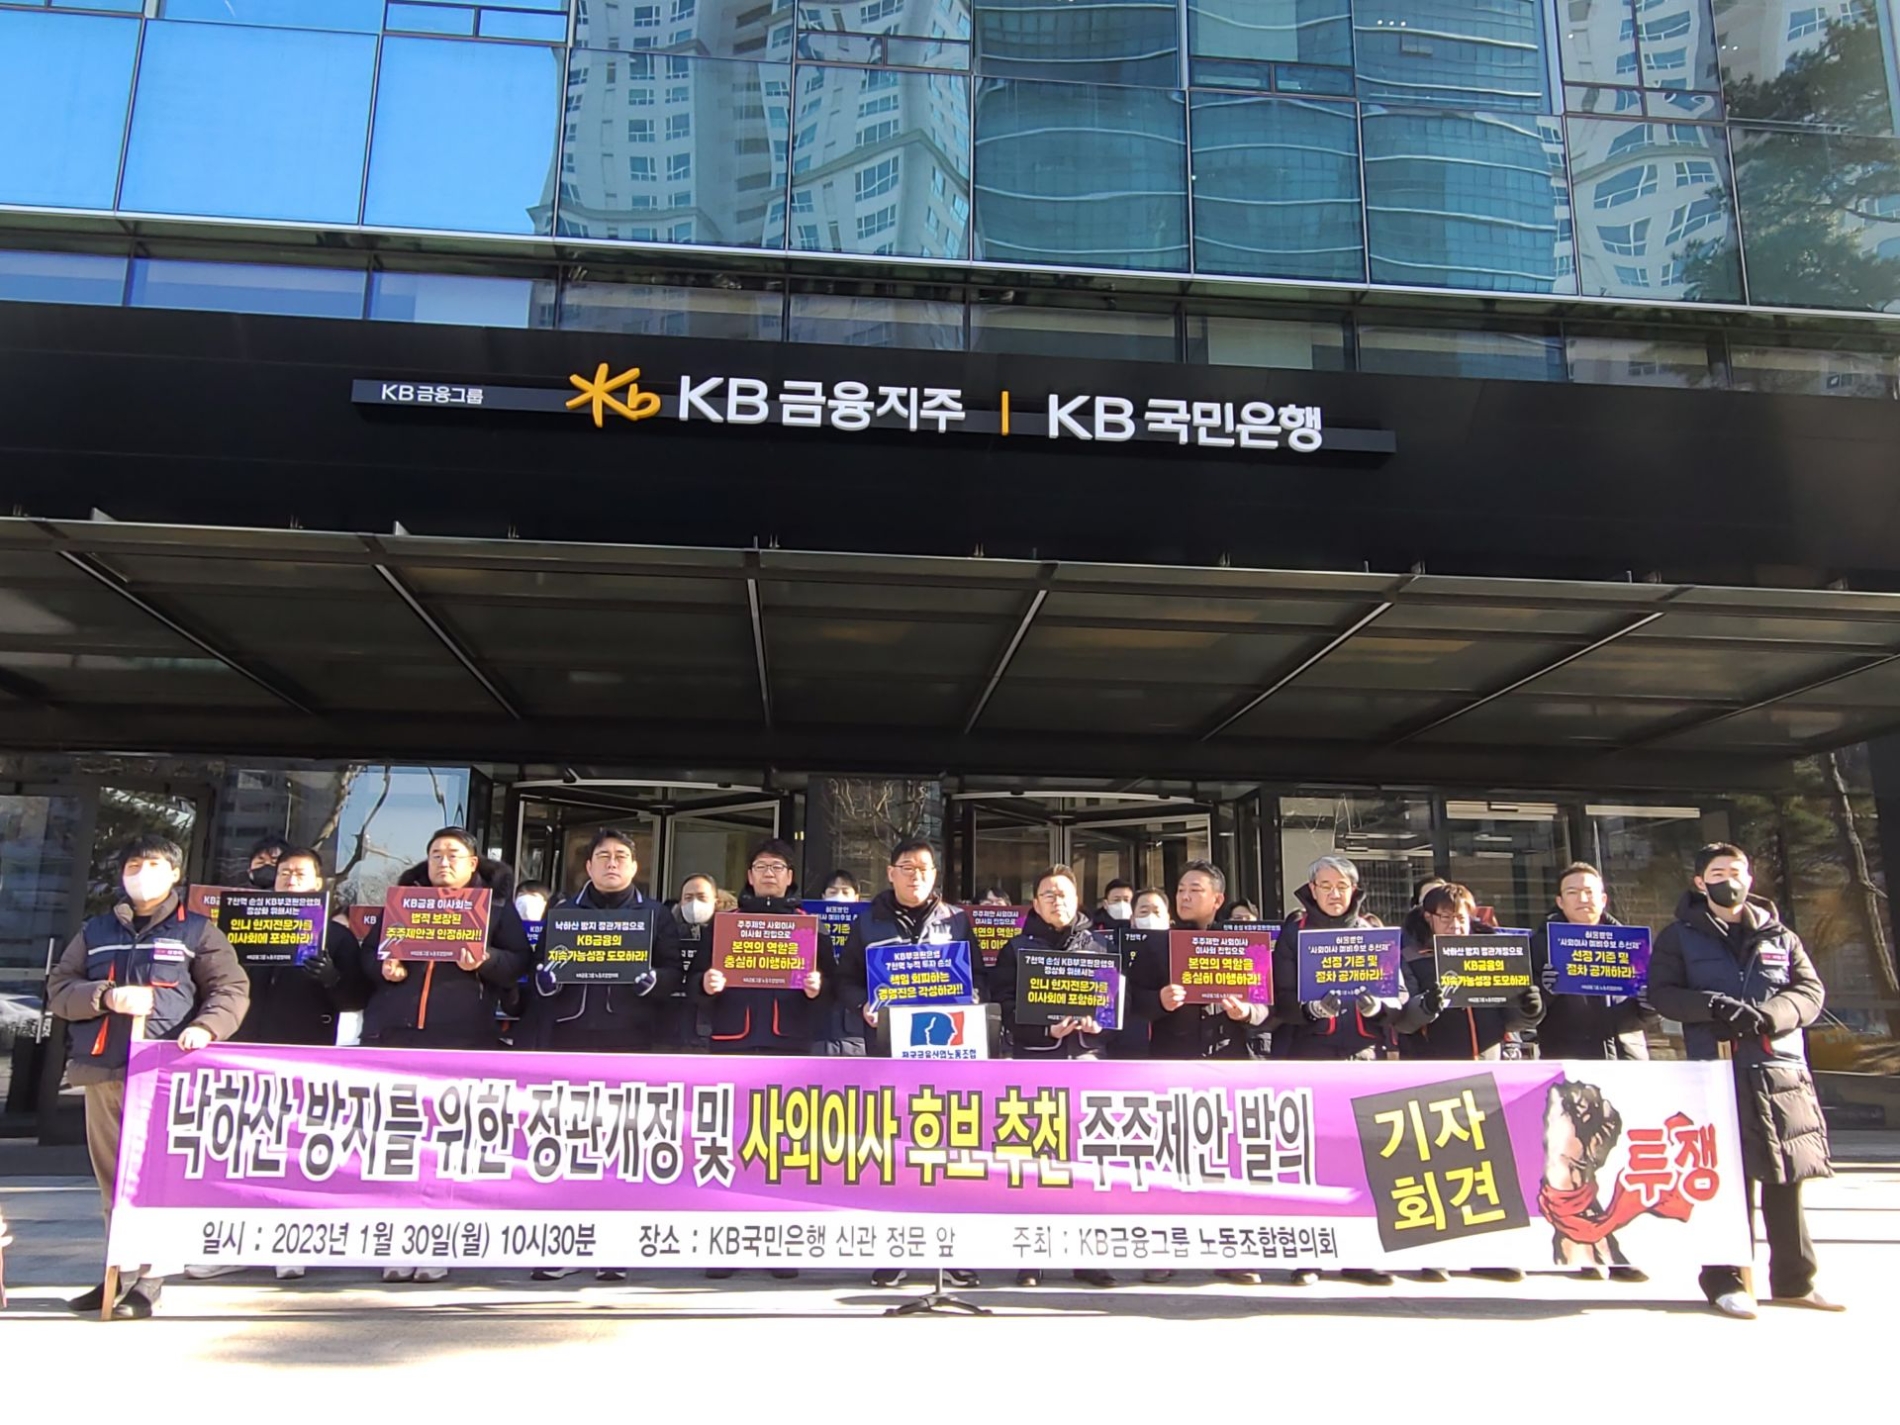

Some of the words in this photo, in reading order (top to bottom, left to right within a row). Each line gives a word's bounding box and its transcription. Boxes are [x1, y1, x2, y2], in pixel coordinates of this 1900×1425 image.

[381, 384, 484, 405] KB금융그룹
[679, 375, 966, 434] KB금융지주
[1048, 394, 1323, 453] KB국민은행
[403, 898, 435, 908] KB금융
[437, 899, 473, 910] 이사회는
[230, 918, 251, 930] 인니
[411, 912, 431, 924] 법적
[432, 913, 462, 925] 보장된
[737, 920, 766, 929] 주주제안
[767, 921, 796, 930] 사외이사
[555, 921, 579, 931] 낙하산
[227, 932, 268, 944] 이사회에
[269, 932, 313, 945] 포함하라!
[386, 927, 435, 940] 주주제안권
[436, 928, 482, 941] 인정하라!!
[576, 934, 622, 946] KB금융의
[732, 941, 764, 953] 본연의
[766, 942, 799, 954] 역할을
[606, 950, 648, 962] 도모하라!
[724, 955, 756, 968] 충실히
[758, 957, 805, 970] 이행하라!
[1321, 956, 1342, 968] 선정
[1344, 955, 1365, 967] 기준
[1367, 955, 1378, 967] 및
[1571, 950, 1593, 962] 선정
[1595, 951, 1616, 963] 기준
[1618, 952, 1629, 964] 및
[1188, 957, 1220, 970] 본연의
[1222, 958, 1254, 971] 역할을
[1463, 960, 1504, 971] KB금융의
[1566, 963, 1587, 976] 절차
[1590, 964, 1636, 978] 공개하라!
[890, 974, 909, 985] 책임
[911, 972, 950, 984] 회피하는
[1181, 972, 1213, 984] 충실히
[1215, 973, 1262, 986] 이행하라!
[1315, 970, 1336, 983] 절차
[1338, 968, 1384, 982] 공개하라!
[1493, 975, 1530, 986] 도모하라!
[1030, 978, 1049, 990] 인니
[1028, 991, 1066, 1005] 이사회에
[1067, 992, 1110, 1007] 포함하라!
[171, 1073, 293, 1175] 낙하산
[304, 1079, 423, 1177] 방지를
[436, 1083, 515, 1176] 위한
[527, 1085, 681, 1180] 정관개정
[694, 1089, 731, 1182] 및
[742, 1086, 899, 1184] 사외이사
[908, 1087, 987, 1185] 후보
[994, 1087, 1072, 1187] 추천
[1079, 1093, 1230, 1187] 주주제안
[1240, 1092, 1312, 1186] 발의
[1374, 1089, 1487, 1164] 기자
[1623, 1112, 1720, 1203] 투쟁
[1390, 1160, 1507, 1231] 회견
[202, 1220, 245, 1256] 일시
[272, 1221, 349, 1257] 2023년
[359, 1221, 393, 1256] 1월
[402, 1221, 490, 1259] 30일(월)
[501, 1222, 596, 1258] 10시30분
[638, 1223, 681, 1257] 장소
[709, 1223, 826, 1259] KB국민은행
[836, 1225, 877, 1258] 신관
[886, 1226, 926, 1258] 정문
[935, 1226, 956, 1259] 앞
[1012, 1226, 1051, 1259] 주최
[1079, 1226, 1191, 1258] KB금융그룹
[1200, 1226, 1338, 1259] 노동조합협의회
